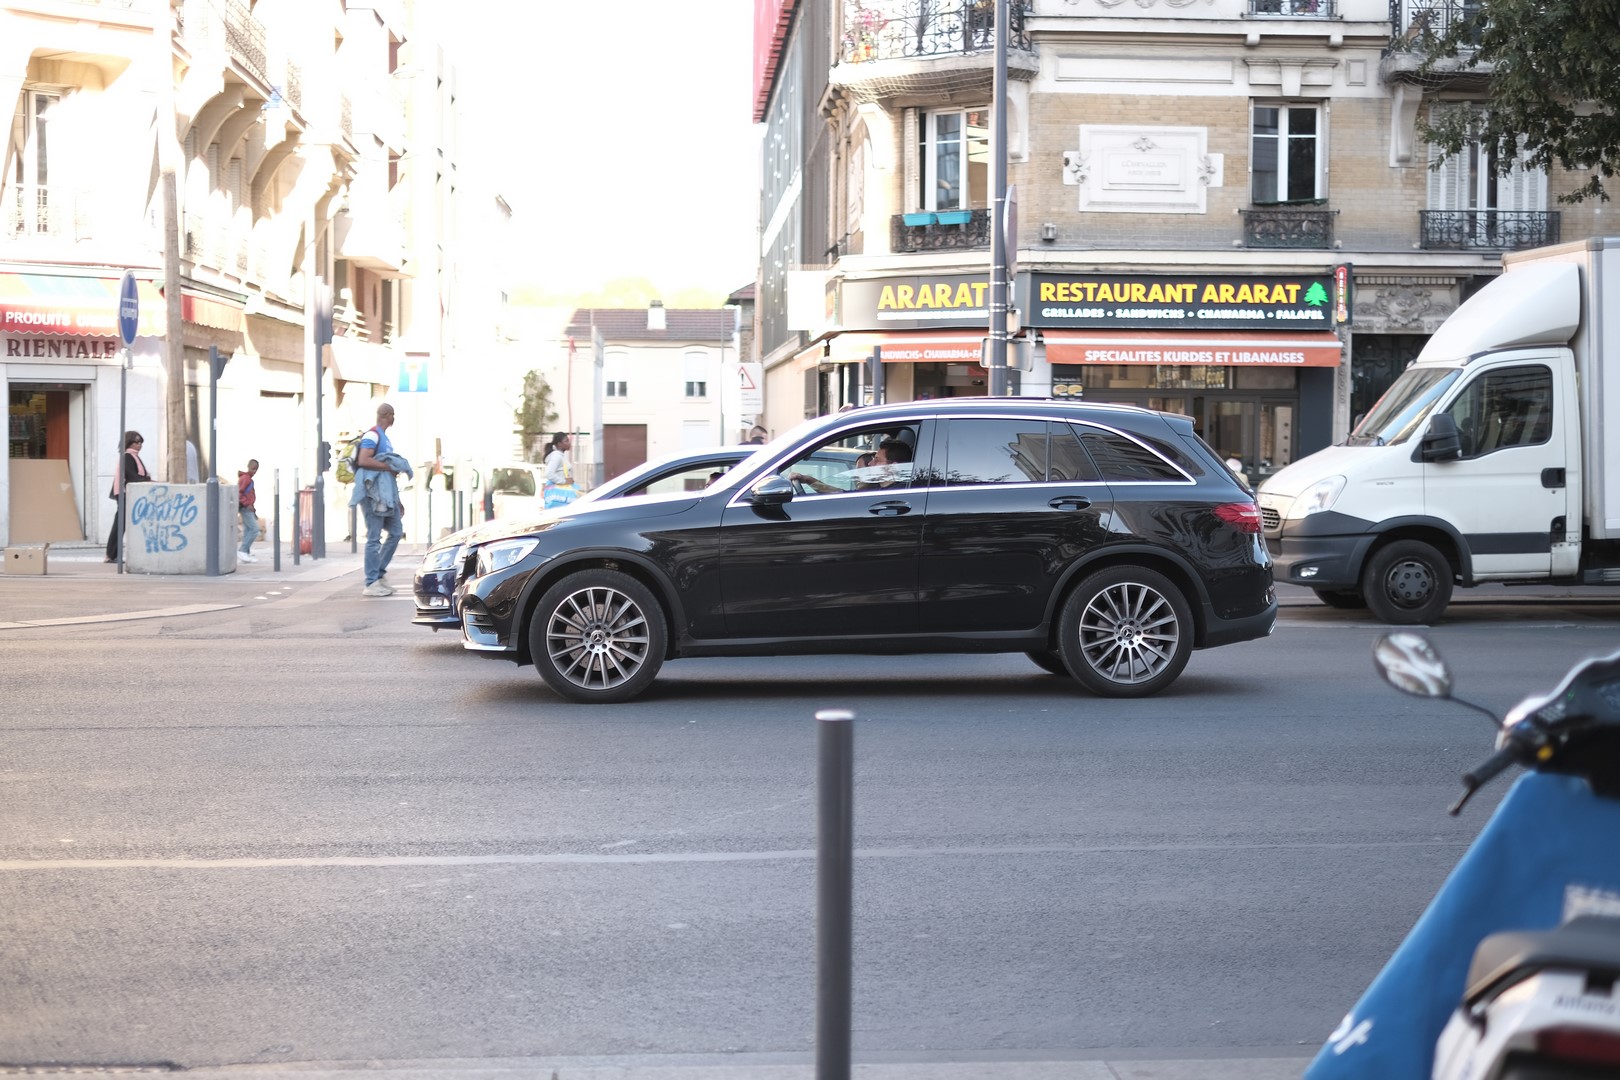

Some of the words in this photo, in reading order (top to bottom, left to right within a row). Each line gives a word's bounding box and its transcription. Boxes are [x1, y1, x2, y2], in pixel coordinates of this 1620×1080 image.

[877, 282, 989, 310] ARARAT
[1040, 282, 1198, 303] RESTAURANT
[1201, 283, 1302, 304] ARARAT
[5, 311, 71, 326] PRODUITS
[1041, 308, 1105, 318] GRILLADES
[1115, 309, 1185, 319] SANDWICHS
[1197, 309, 1265, 319] CHAWARMA
[1275, 310, 1325, 320] FALAFEL
[6, 338, 116, 359] RIENTALE
[880, 350, 919, 360] ANDWICHS
[1085, 350, 1162, 362] SPECIALITES
[1163, 350, 1213, 362] KURDES
[1215, 351, 1231, 362] ET
[1232, 351, 1305, 363] LIBANAISES
